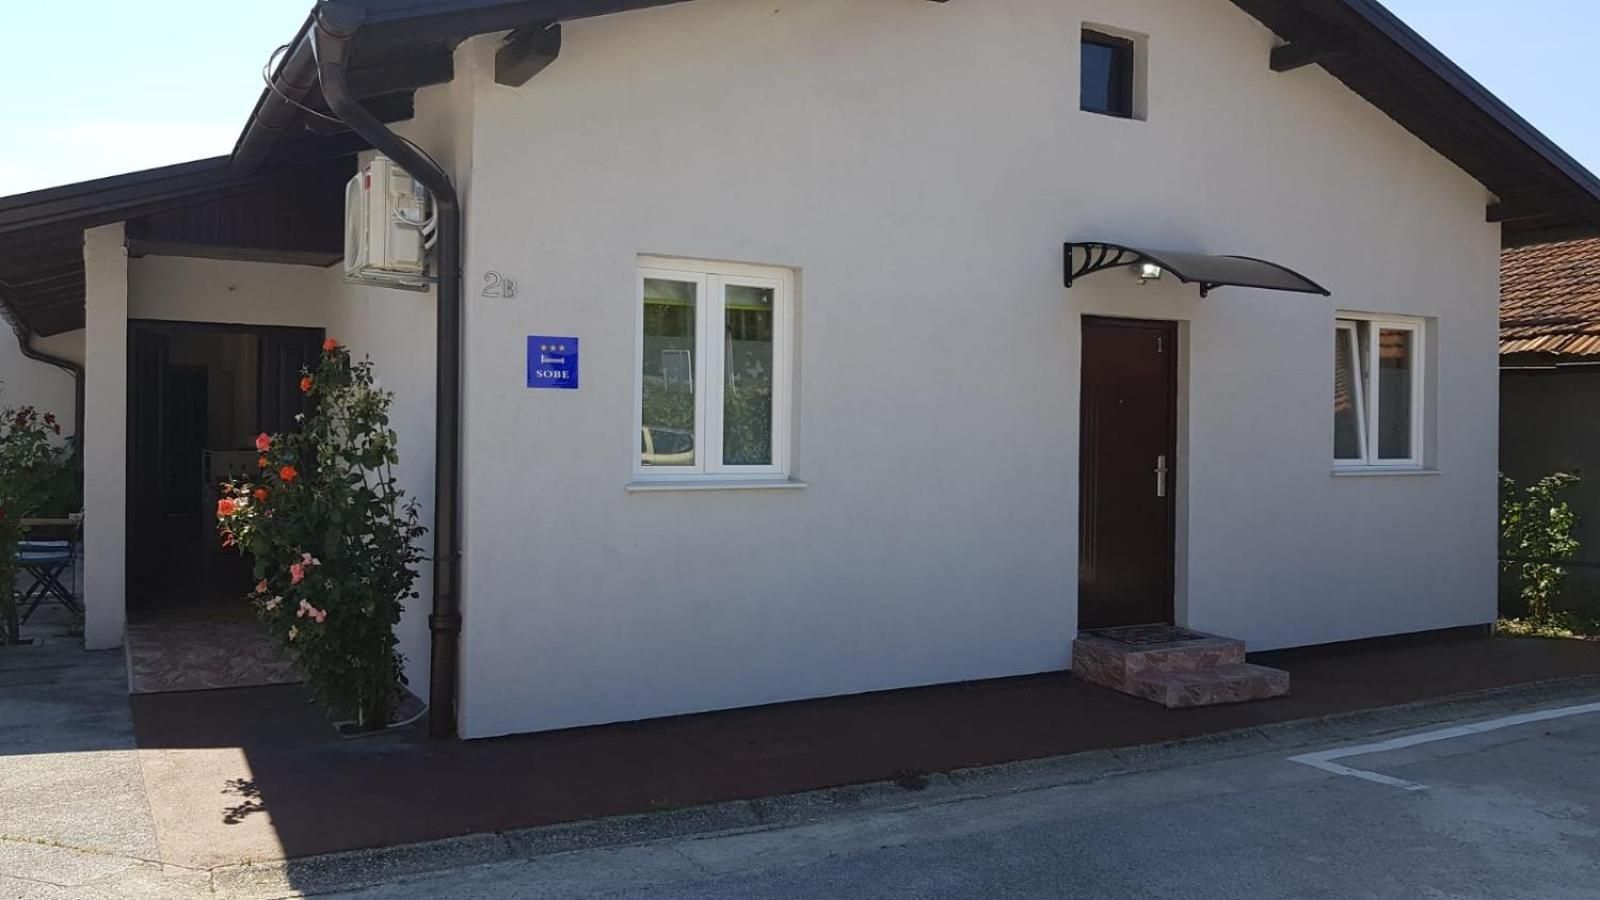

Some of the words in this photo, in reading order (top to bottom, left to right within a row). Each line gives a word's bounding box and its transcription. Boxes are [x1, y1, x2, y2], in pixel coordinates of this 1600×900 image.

[481, 270, 519, 299] 2B
[1156, 336, 1163, 353] 1
[536, 369, 570, 379] SOBE
